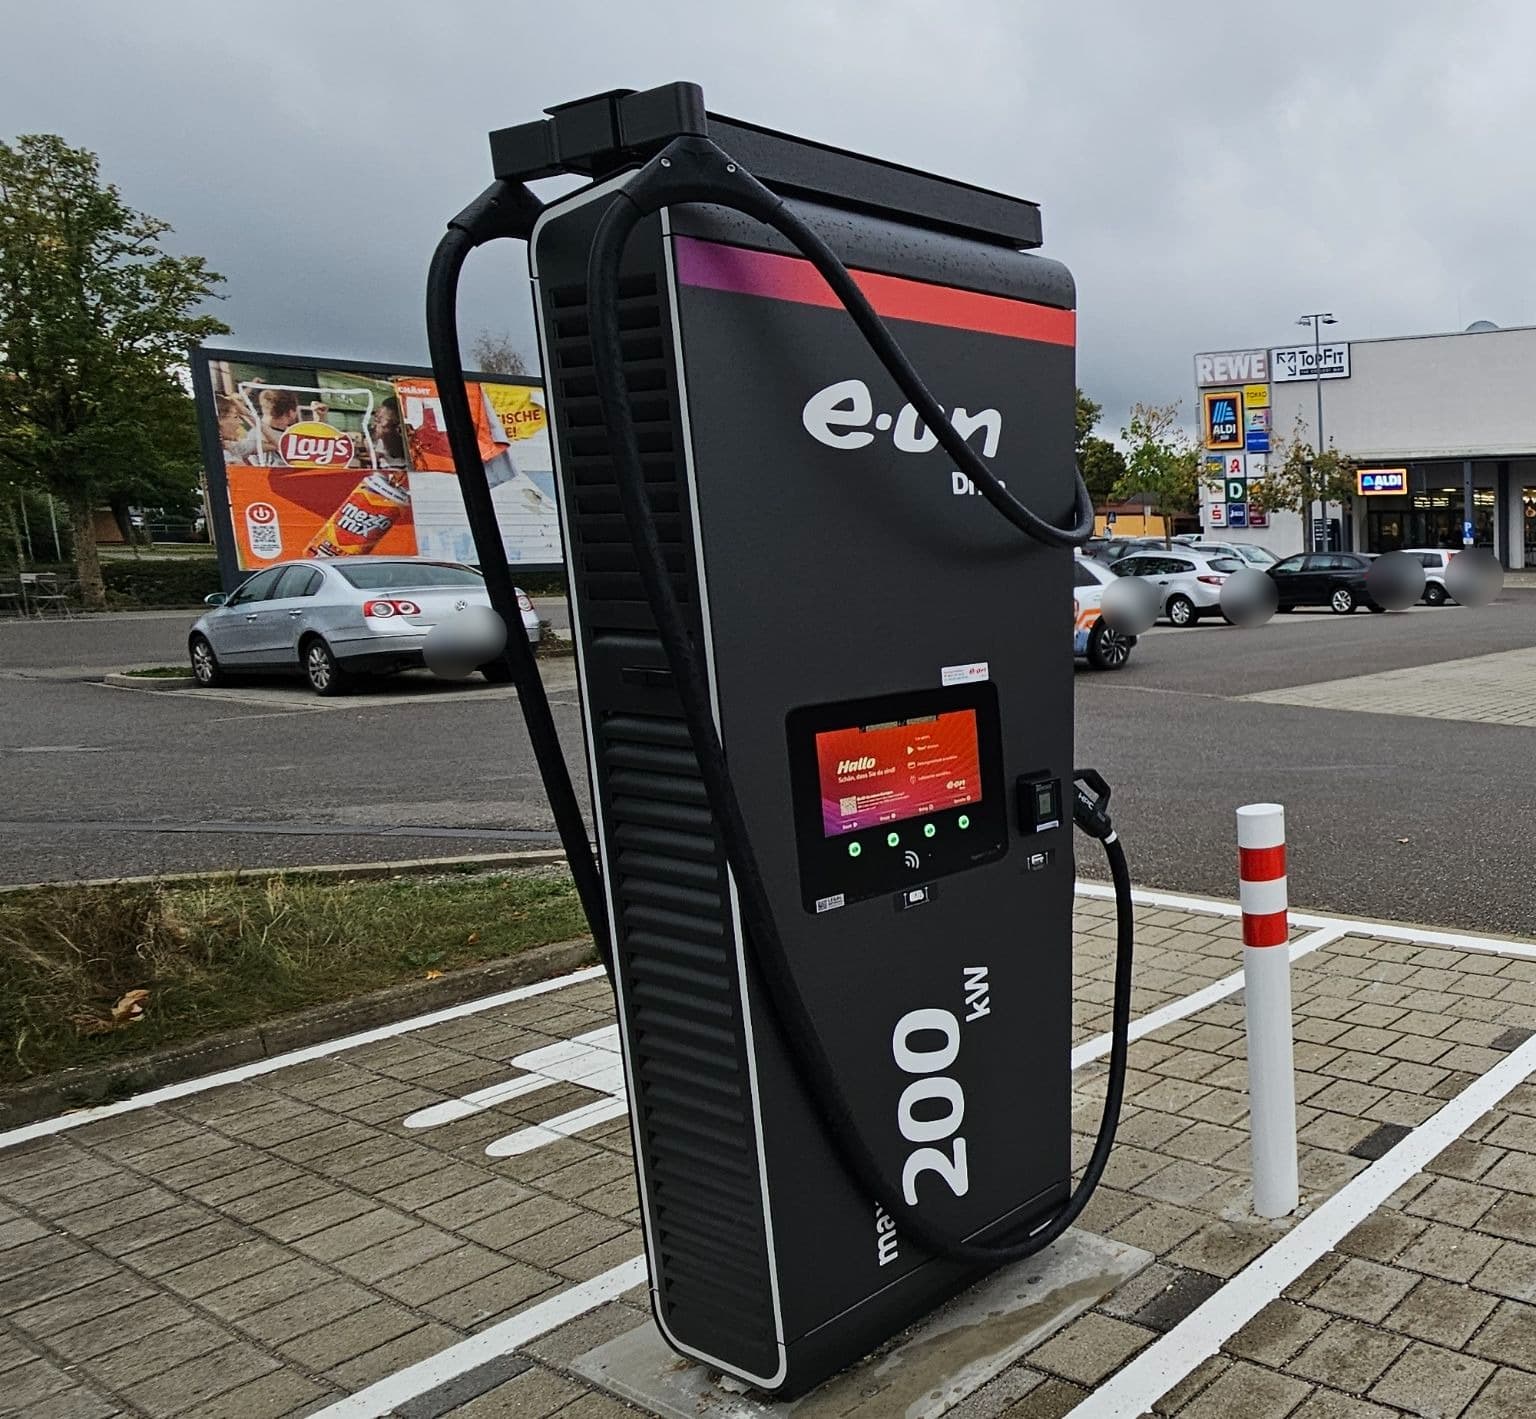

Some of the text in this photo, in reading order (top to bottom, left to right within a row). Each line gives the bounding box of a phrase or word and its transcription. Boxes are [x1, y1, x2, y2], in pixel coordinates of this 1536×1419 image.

[1197, 354, 1266, 382] REWE
[497, 409, 541, 425] ISCHE
[1212, 424, 1236, 436] ALDI
[1374, 474, 1402, 486] ALDI
[837, 756, 876, 775] Hallo
[963, 966, 991, 1022] kW
[892, 1008, 969, 1206] 200
